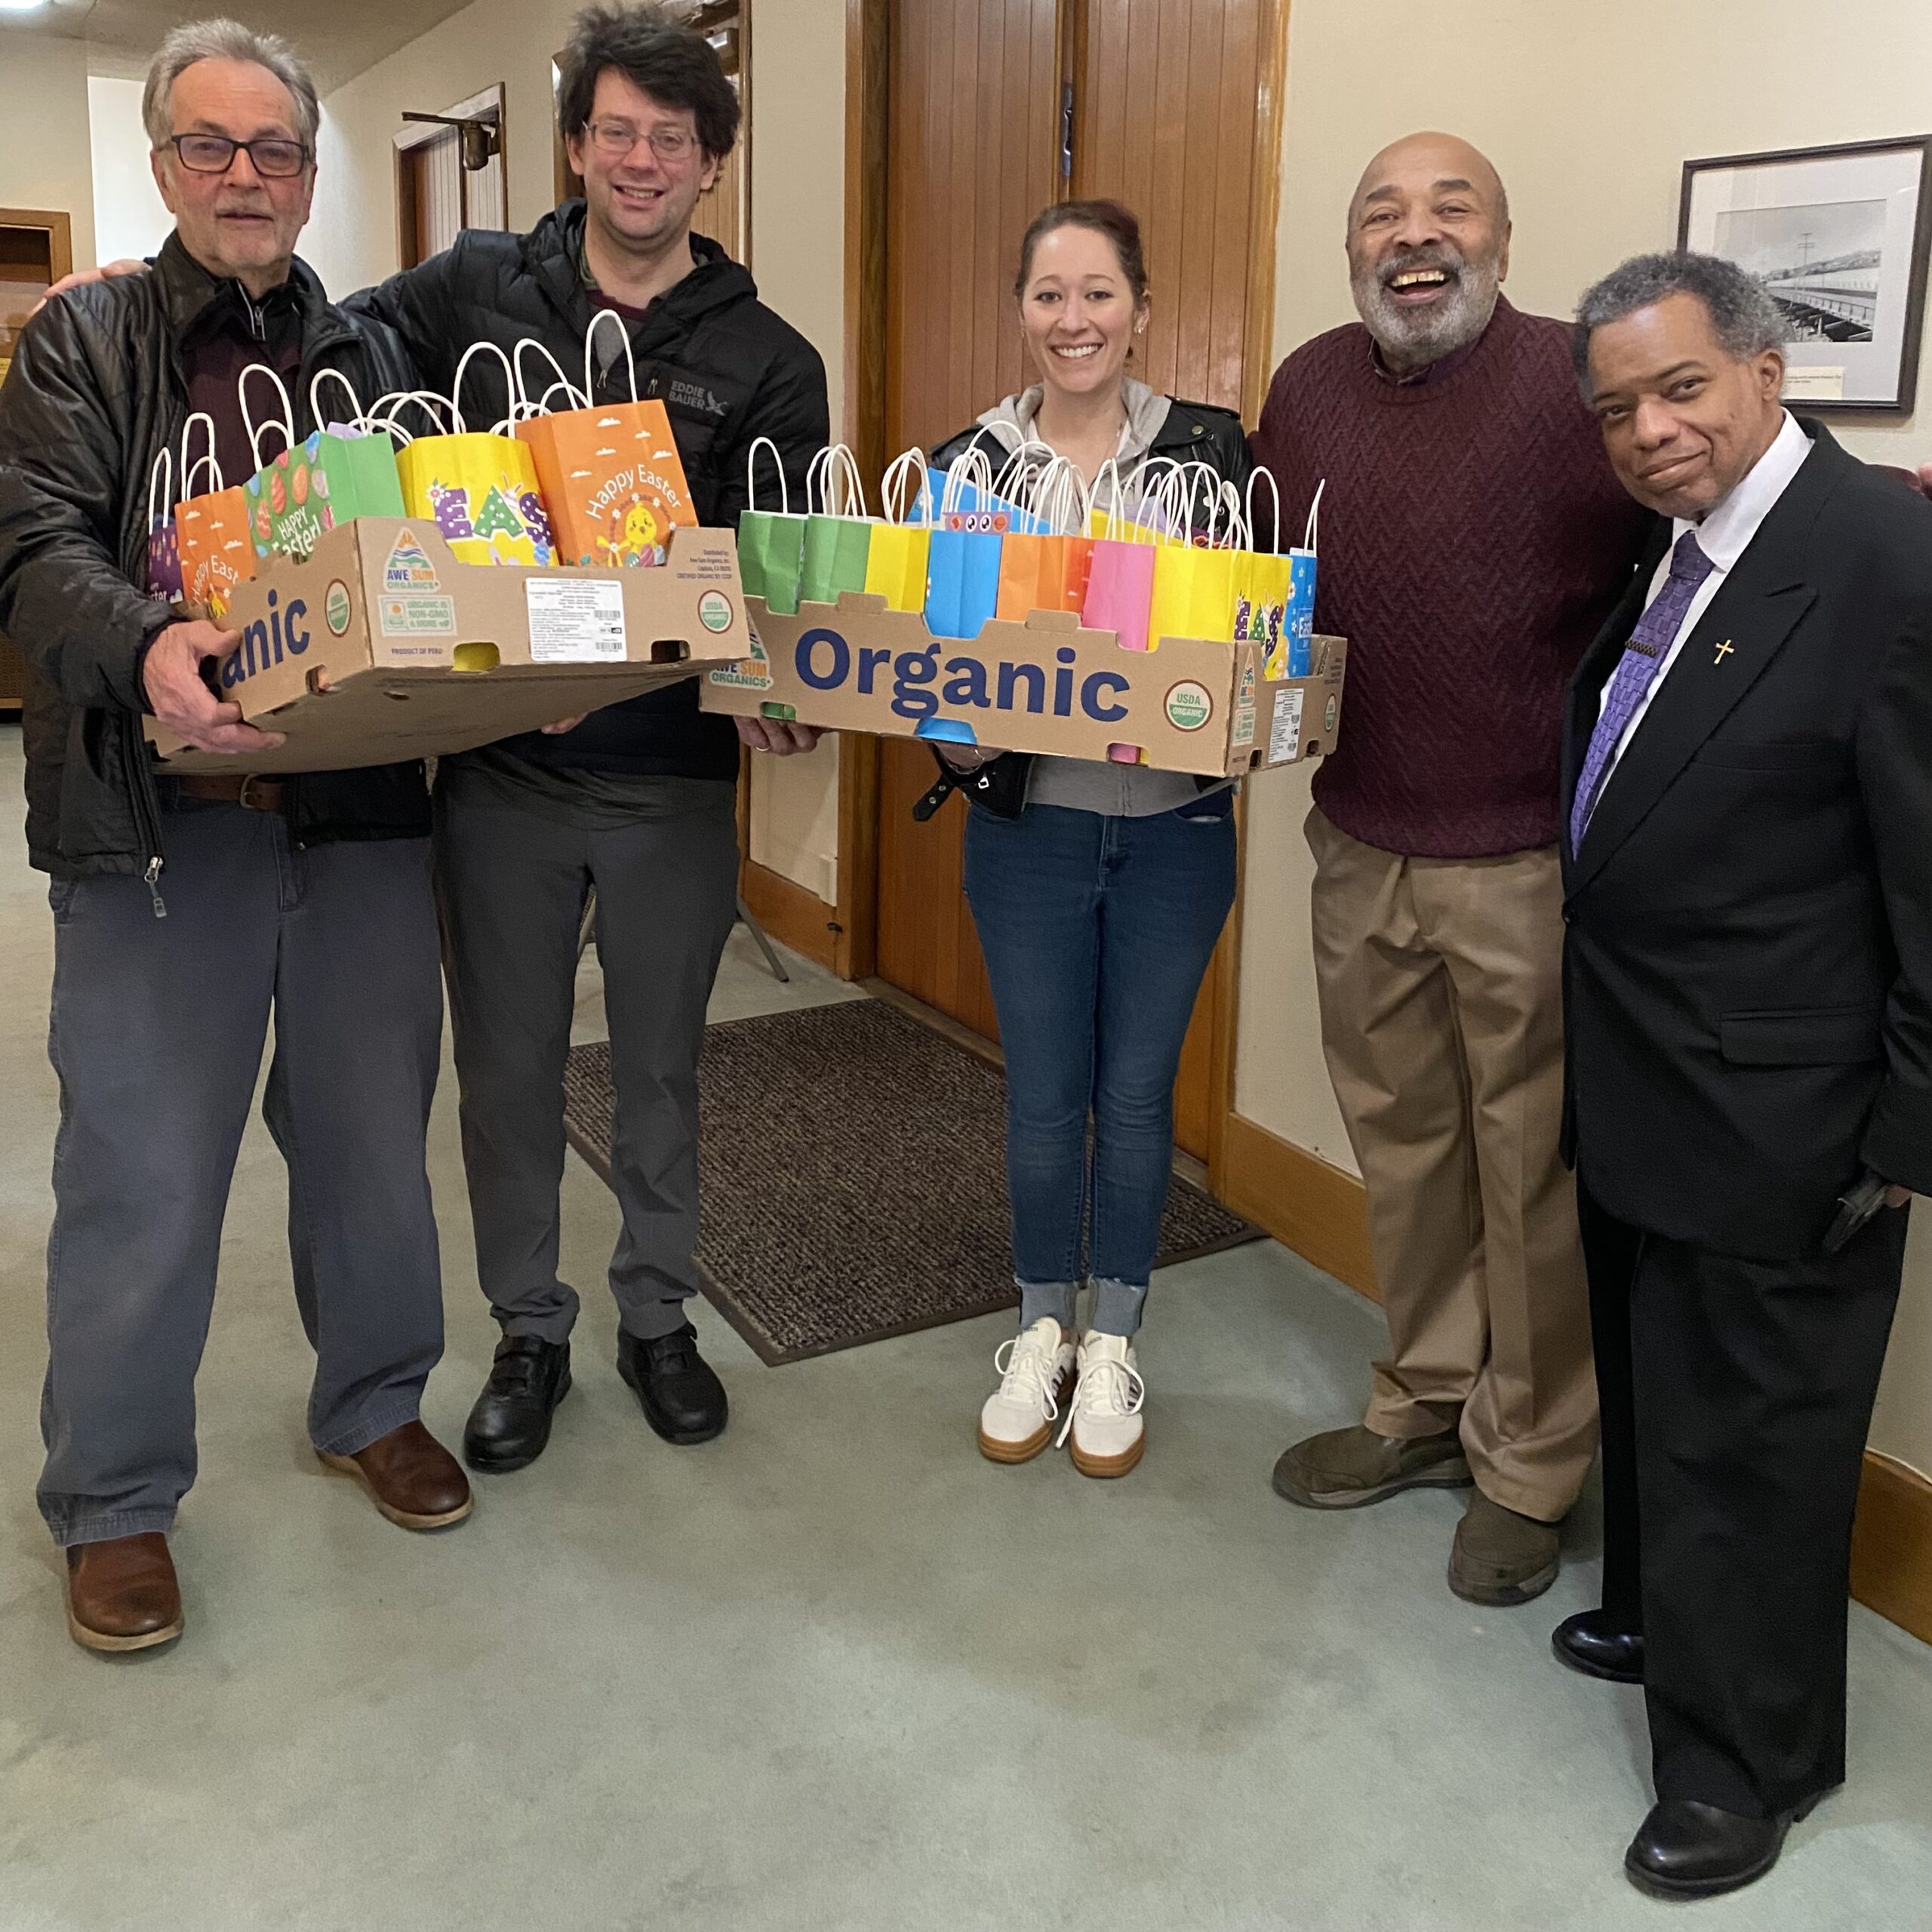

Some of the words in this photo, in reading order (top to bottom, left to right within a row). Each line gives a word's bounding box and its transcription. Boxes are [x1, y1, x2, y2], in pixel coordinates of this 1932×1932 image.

[671, 380, 706, 398] EDDIE
[669, 391, 706, 410] BAUER
[586, 469, 635, 519] Happy
[638, 464, 681, 508] Easter
[278, 506, 308, 540] HAPPY
[433, 485, 555, 547] EAS
[387, 570, 409, 580] AWE
[411, 570, 434, 580] SUM
[408, 610, 448, 618] NON-GMO
[222, 589, 310, 688] anic
[740, 661, 767, 677] SUM
[795, 628, 1131, 722] Organic
[712, 672, 767, 688] ORGANICS
[1177, 694, 1201, 705] USDA
[1173, 706, 1203, 718] ORGANIC
